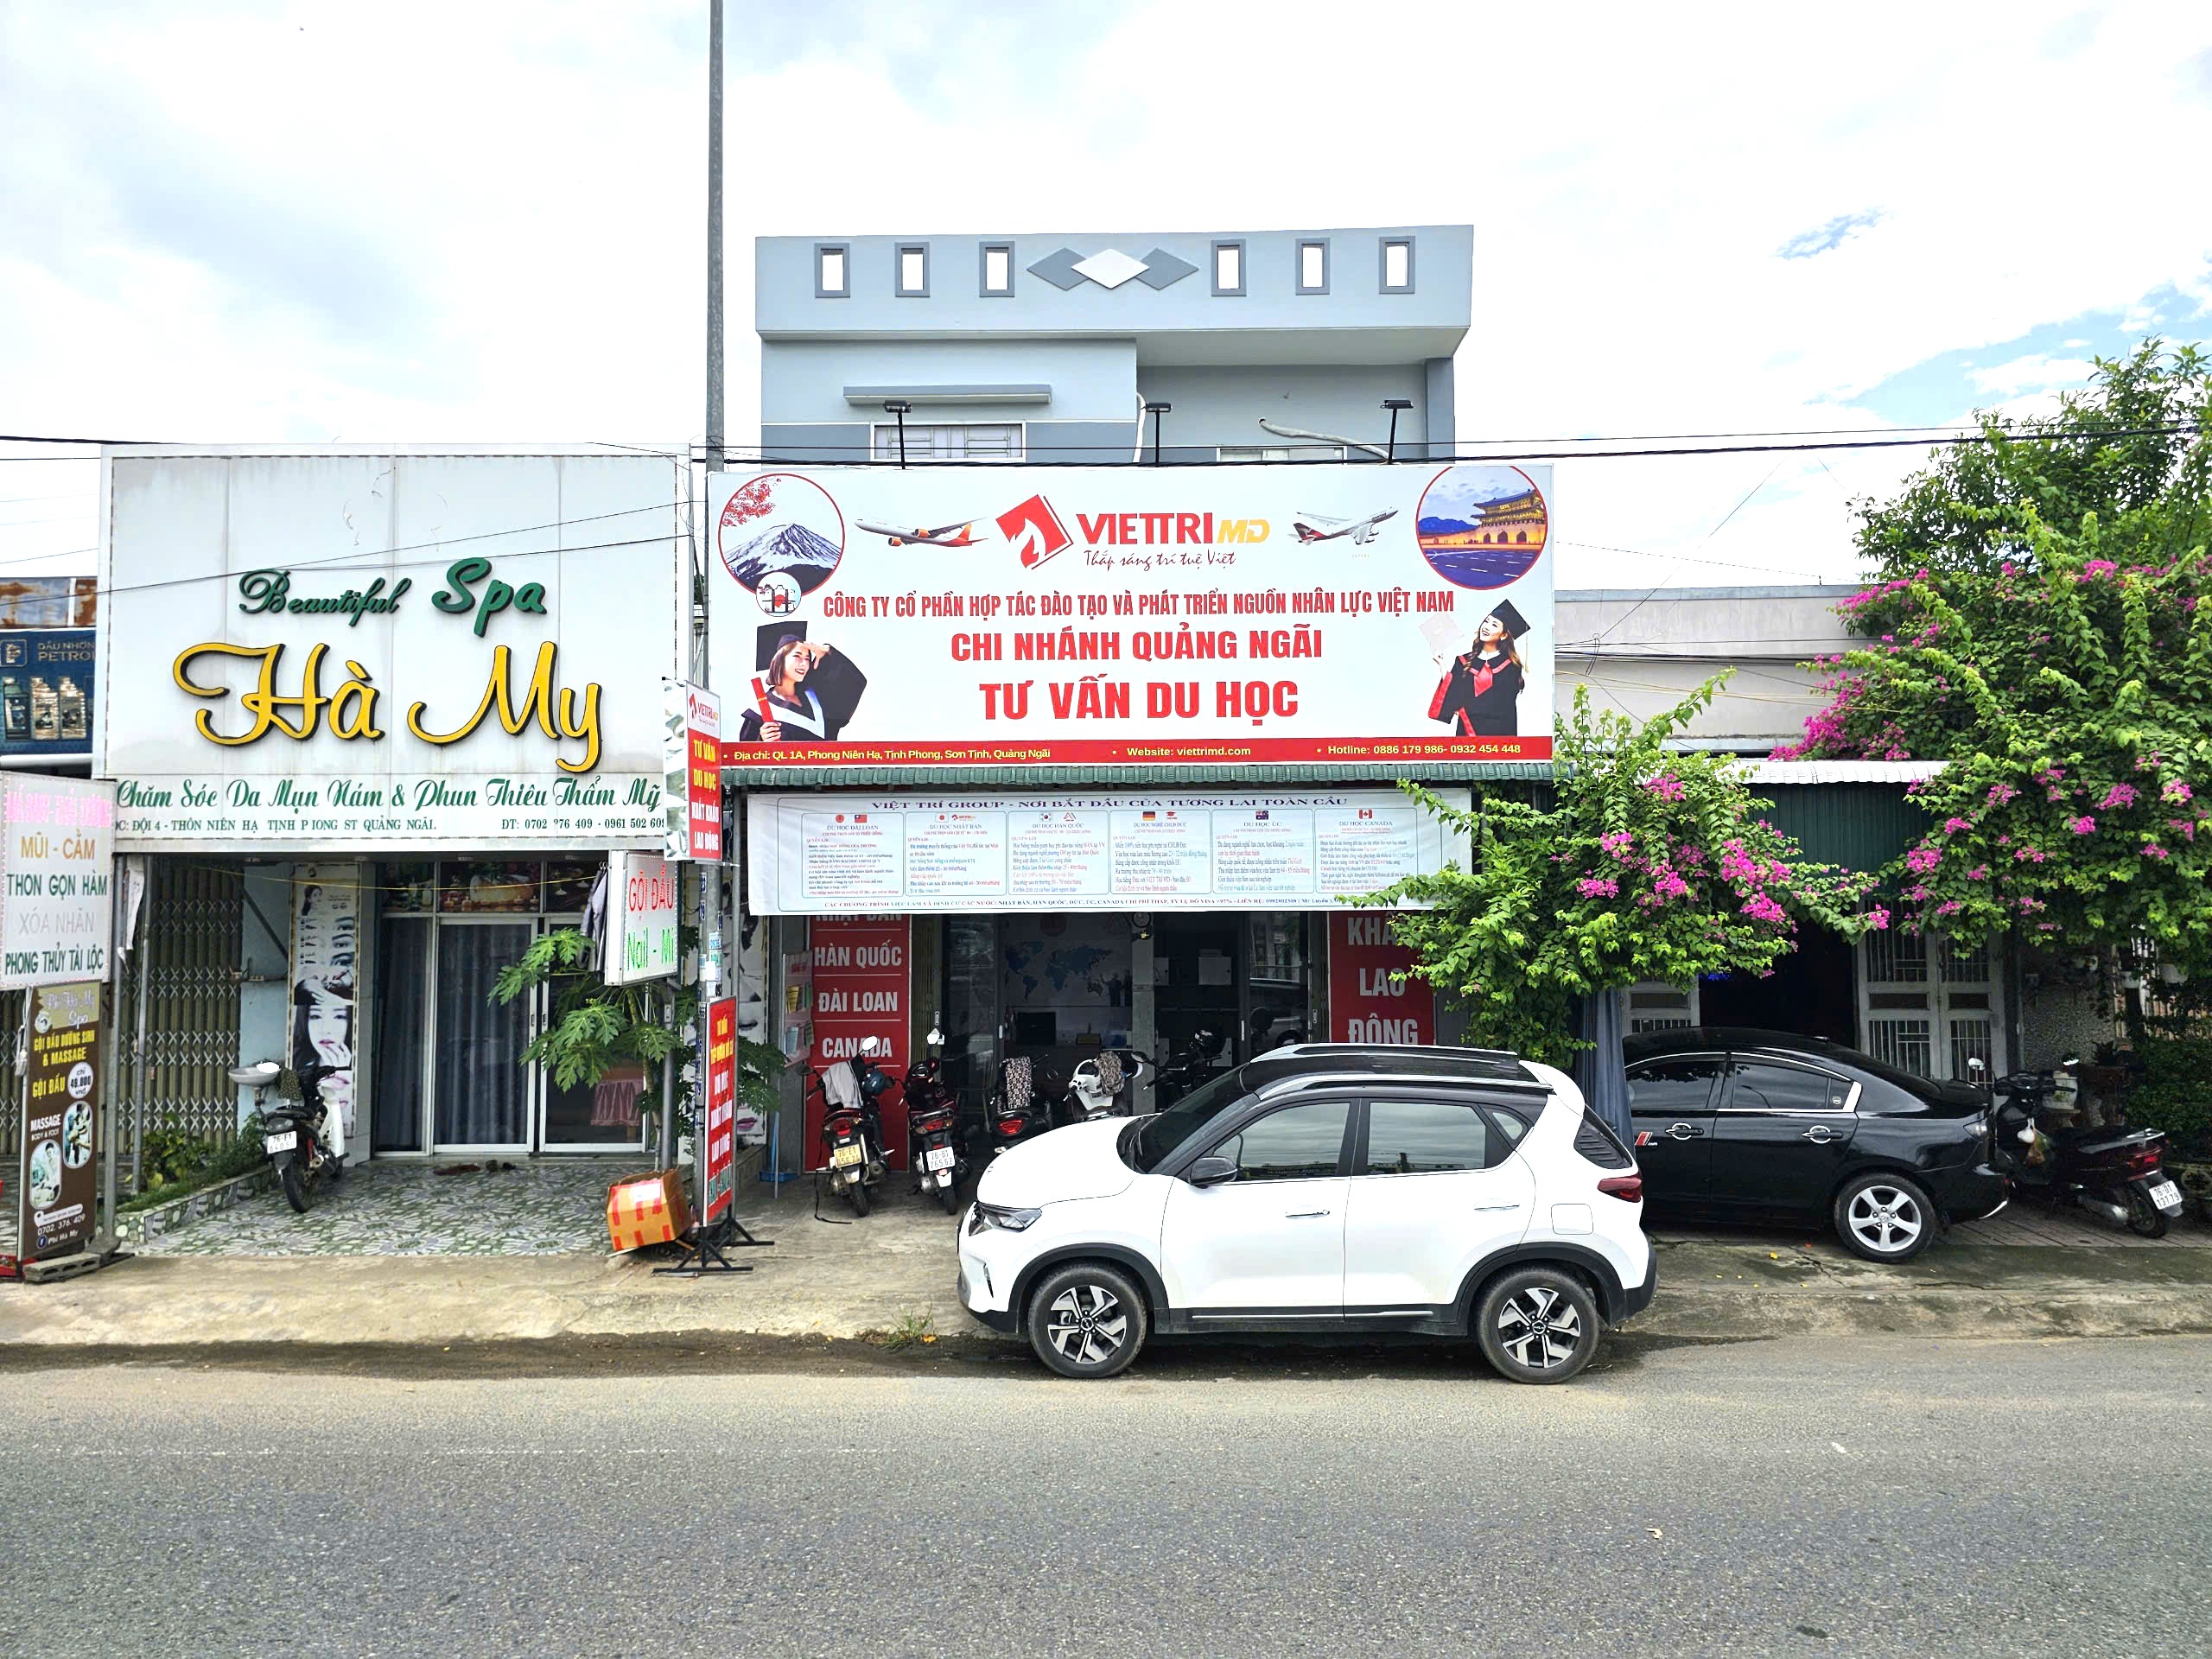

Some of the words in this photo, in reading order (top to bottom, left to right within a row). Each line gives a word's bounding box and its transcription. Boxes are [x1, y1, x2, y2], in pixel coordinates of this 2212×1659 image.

[1076, 512, 1213, 544] VIETTRI
[1217, 519, 1270, 543] MD
[1084, 550, 1116, 572] Thắp
[1120, 553, 1153, 571] sáng
[1156, 553, 1175, 565] trí
[1179, 554, 1203, 569] tuệ
[1207, 549, 1236, 569] Việt
[239, 569, 411, 626] Beautiful
[432, 557, 547, 637] Spa
[823, 591, 866, 618] CÔNG
[872, 596, 890, 617] TY
[895, 590, 917, 617] CỔ
[922, 591, 963, 617] PHẦN
[969, 594, 1001, 621] HỢP
[1007, 590, 1035, 616] TÁC
[1040, 590, 1072, 616] ĐÀO
[1078, 594, 1107, 620] TẠO
[1113, 589, 1134, 615] VÀ
[1139, 589, 1179, 615] PHÁT
[1184, 588, 1227, 614] TRIỂN
[1233, 588, 1286, 614] NGUỒN
[1293, 588, 1335, 613] NHÂN
[1340, 591, 1372, 618] LỰC
[1377, 587, 1410, 617] VIỆT
[1416, 590, 1453, 613] NAM
[950, 632, 1002, 661] CHI
[1014, 626, 1121, 661] NHÁNH
[1132, 621, 1237, 662] QUẢNG
[1249, 623, 1322, 659] NGÃI
[38, 651, 95, 662] PETRO
[173, 642, 385, 746] Hà
[407, 641, 602, 773] My
[979, 679, 1034, 720] TƯ
[1049, 673, 1130, 720] VẤN
[1147, 682, 1200, 719] DU
[1216, 680, 1299, 726] HỌC
[734, 751, 751, 761] Địa
[772, 751, 788, 760] QL
[790, 751, 806, 760] 1A,
[808, 750, 840, 761] Phong
[842, 750, 864, 760] Niên
[867, 750, 883, 761] Hạ,
[885, 750, 906, 760] Tịnh
[908, 750, 943, 760] Phong,
[945, 750, 966, 759] Sơn
[968, 749, 992, 760] Tịnh,
[994, 749, 1027, 760] Quảng
[1028, 749, 1051, 760] Ngãi
[1127, 747, 1174, 756] Website:
[1177, 747, 1251, 756] viettrimd.com
[1328, 746, 1370, 754] Hotline:
[1374, 745, 1399, 754] 0886
[1402, 745, 1421, 754] 179
[1451, 745, 1476, 753] 0932
[1479, 745, 1498, 753] 454
[1502, 745, 1521, 753] 448
[117, 779, 173, 808] Chăm
[181, 779, 218, 807] Sóc
[226, 779, 262, 807] Da
[268, 779, 320, 814] Mụn
[327, 779, 385, 807] Nám
[391, 784, 405, 806] &
[415, 779, 479, 811] Phun
[553, 775, 617, 806] Thẩm
[622, 778, 661, 812] Mỹ
[872, 800, 911, 810] VIỆT
[916, 800, 943, 809] TRÍ
[1129, 798, 1162, 807] CỦA
[132, 817, 151, 834] ĐỘI
[155, 820, 160, 830] 4
[172, 817, 201, 831] THÔN
[207, 817, 236, 830] NIÊN
[242, 820, 258, 834] HẠ
[268, 820, 295, 834] TỊNH
[345, 819, 358, 830] ST
[364, 815, 401, 830] QUẢNG
[501, 819, 519, 830] ĐT:
[525, 819, 547, 829] 0702
[575, 818, 593, 829] 409
[605, 818, 626, 829] 0961
[630, 818, 646, 829] 502
[21, 831, 48, 858] MŨI
[7, 874, 41, 896] THON
[49, 874, 76, 900] GỌN
[82, 869, 108, 896] HÀM
[20, 906, 50, 934] XÓA
[5, 950, 39, 975] PHONG
[69, 943, 83, 970] TÀI
[86, 944, 104, 975] LỘC
[627, 926, 648, 970] Nail
[814, 943, 850, 966] HÀN
[855, 939, 902, 968] QUỐC
[1359, 968, 1406, 996] LAO
[818, 988, 848, 1012] ĐÀI
[853, 992, 898, 1012] LOAN
[51, 1046, 87, 1065] MASSAGE
